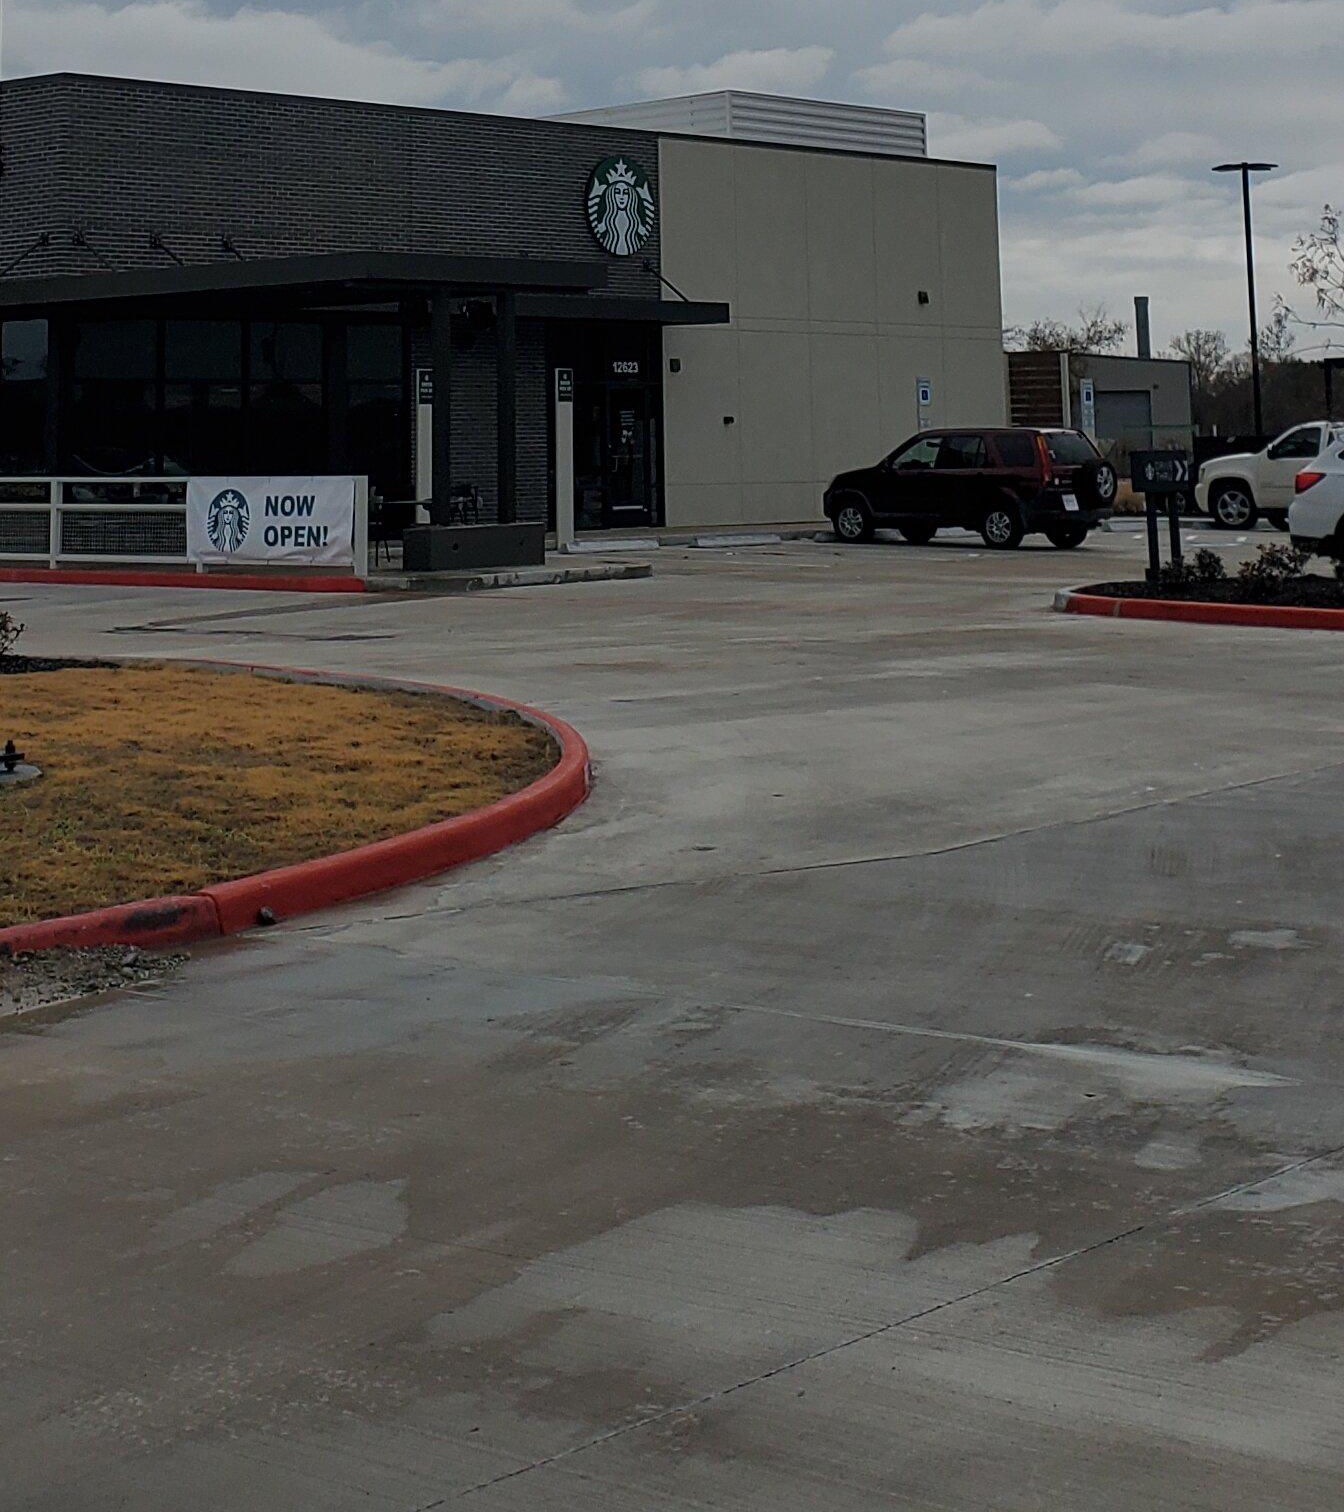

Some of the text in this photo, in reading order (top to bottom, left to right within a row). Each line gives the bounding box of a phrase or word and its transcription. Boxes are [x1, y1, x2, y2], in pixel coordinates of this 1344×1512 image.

[612, 361, 639, 373] 12623
[264, 495, 316, 517] NOW
[263, 525, 329, 547] OPEN!
